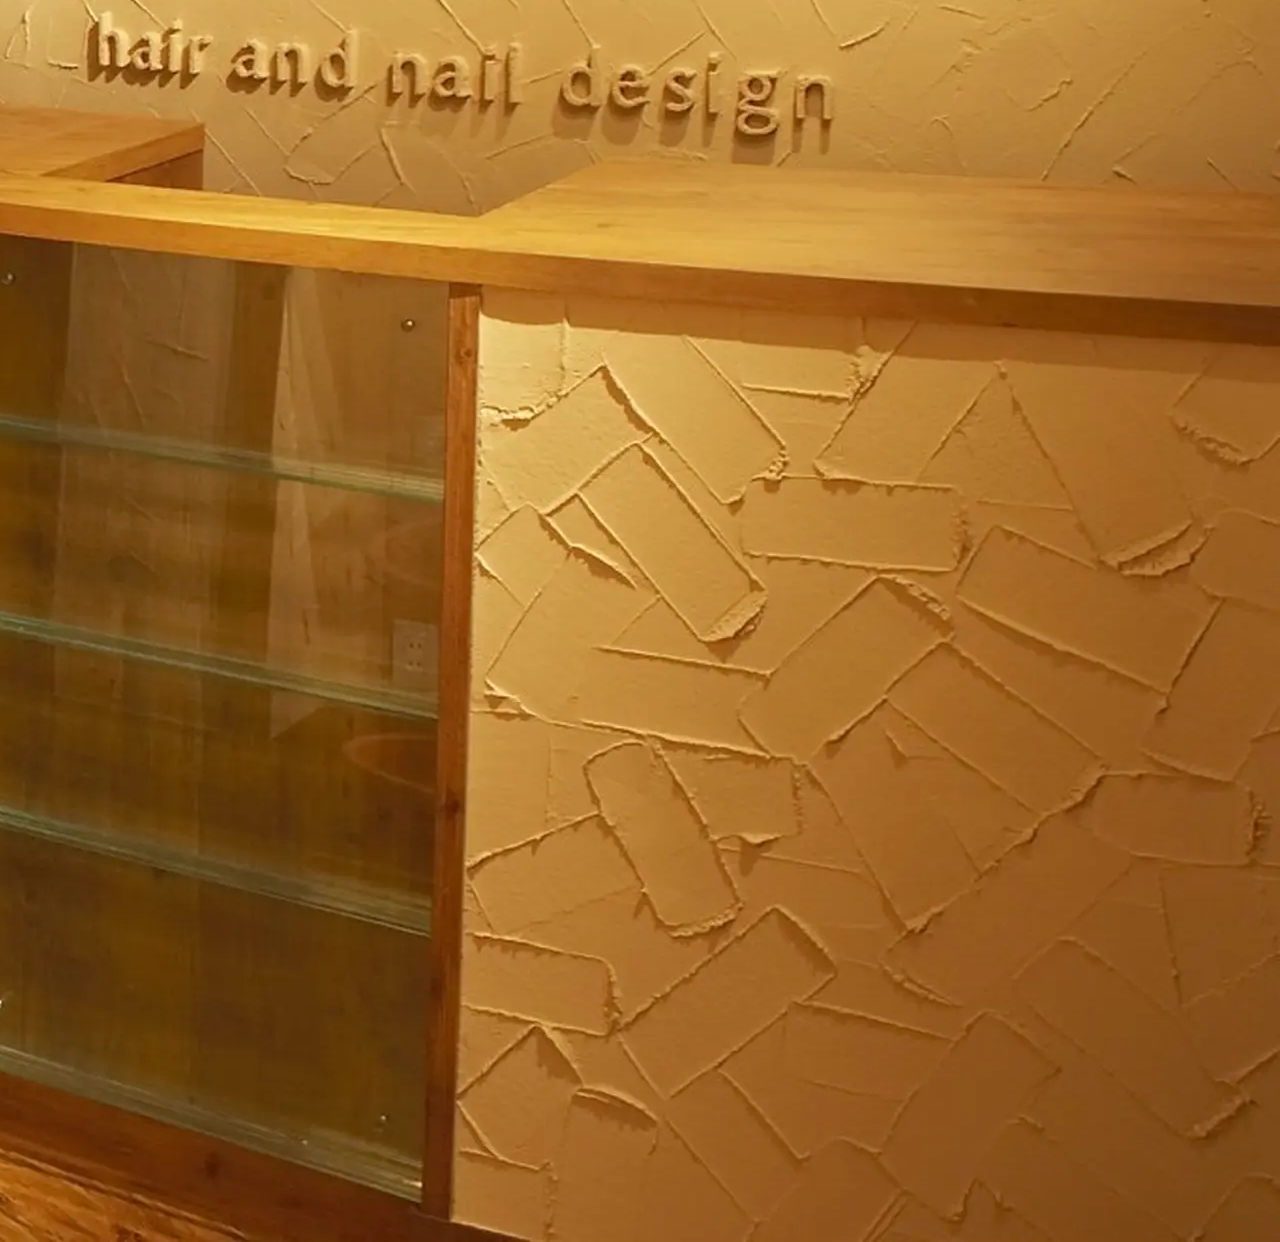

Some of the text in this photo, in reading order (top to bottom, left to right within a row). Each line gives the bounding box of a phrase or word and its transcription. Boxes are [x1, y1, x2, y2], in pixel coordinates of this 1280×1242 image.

[92, 11, 835, 138] hair and nail design
